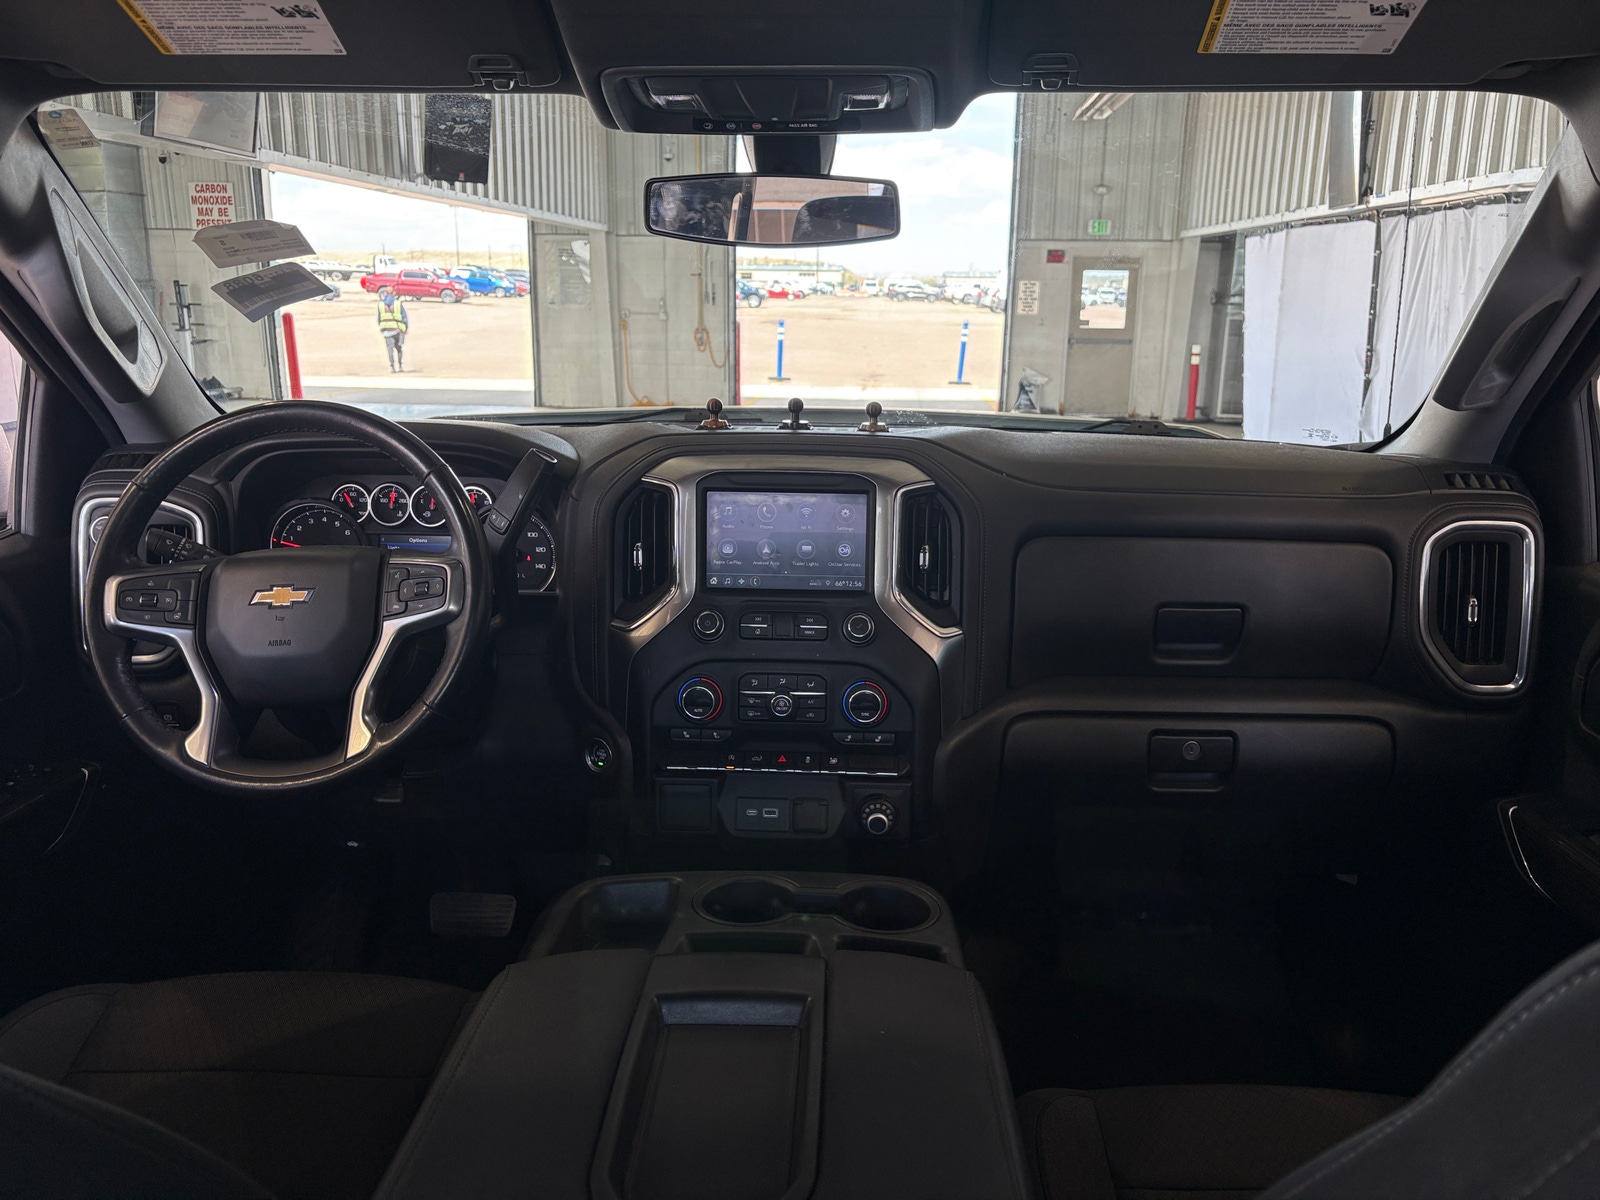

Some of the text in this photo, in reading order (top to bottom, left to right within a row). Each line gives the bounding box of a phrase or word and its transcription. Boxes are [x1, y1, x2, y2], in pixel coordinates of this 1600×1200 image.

[194, 183, 228, 194] CARBON
[191, 195, 233, 206] MONOXIDE
[197, 207, 230, 217] MAY BE
[268, 639, 292, 647] AIRBAG
